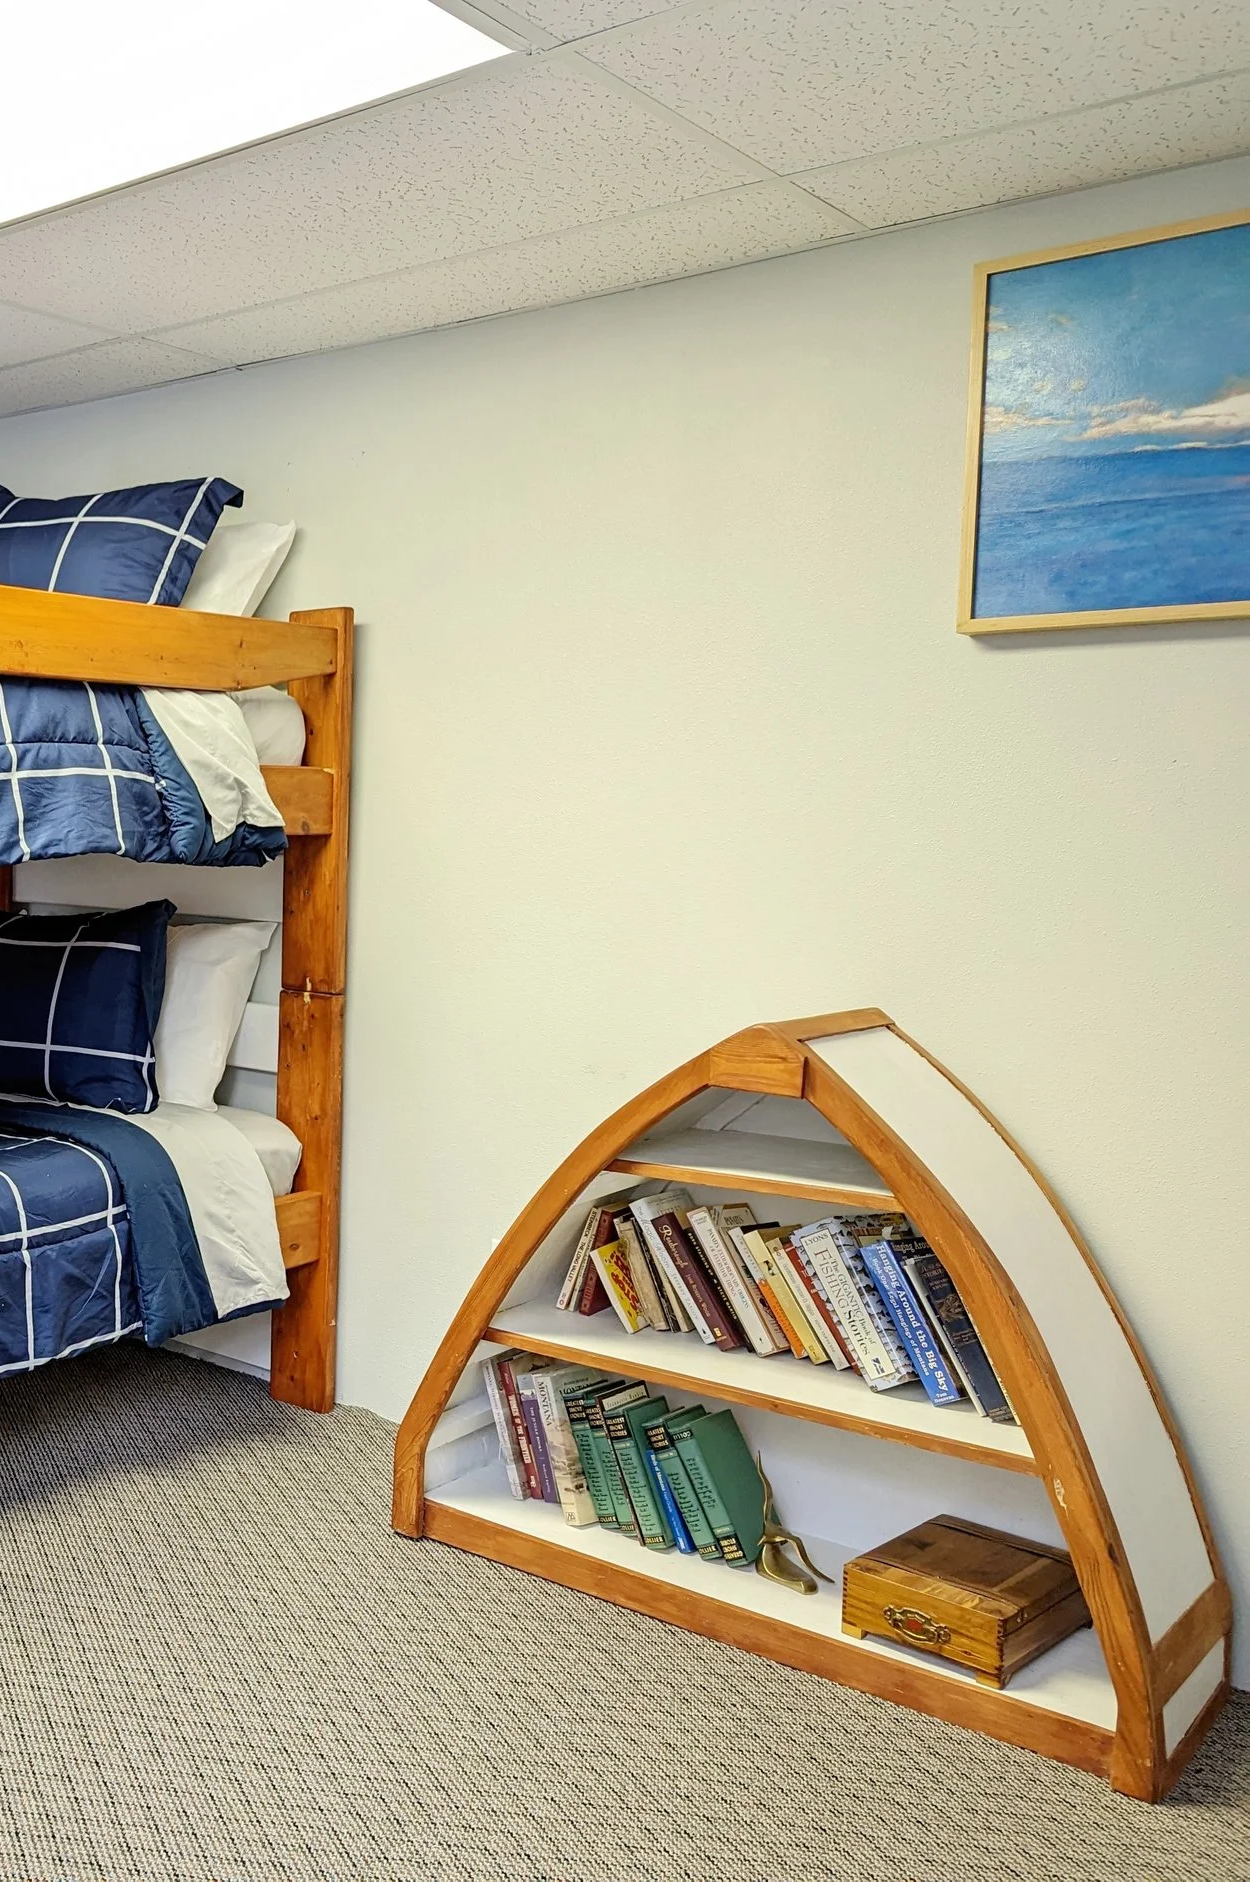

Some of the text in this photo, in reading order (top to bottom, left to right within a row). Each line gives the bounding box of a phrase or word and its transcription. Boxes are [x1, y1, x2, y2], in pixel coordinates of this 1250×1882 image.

[583, 1210, 596, 1237] STEINBECK
[637, 1213, 657, 1241] Magic
[805, 1234, 828, 1246] LYONS
[567, 1264, 576, 1282] VALLEY
[573, 1250, 581, 1264] LONG
[688, 1232, 696, 1245] BORN
[695, 1246, 708, 1268] STANDING
[717, 1286, 726, 1300] STEVE
[725, 1301, 736, 1319] MARTIN
[813, 1248, 849, 1309] FISHING
[843, 1309, 871, 1354] Stories
[829, 1258, 876, 1345] The GIGANTIC Book of
[872, 1257, 883, 1274] Book
[887, 1290, 899, 1308] Legal
[895, 1309, 913, 1339] Hangings
[909, 1339, 917, 1347] of
[913, 1347, 930, 1375] Montana
[875, 1245, 948, 1389] Hanging Around the Big Sky
[537, 1381, 552, 1425] MONTANA
